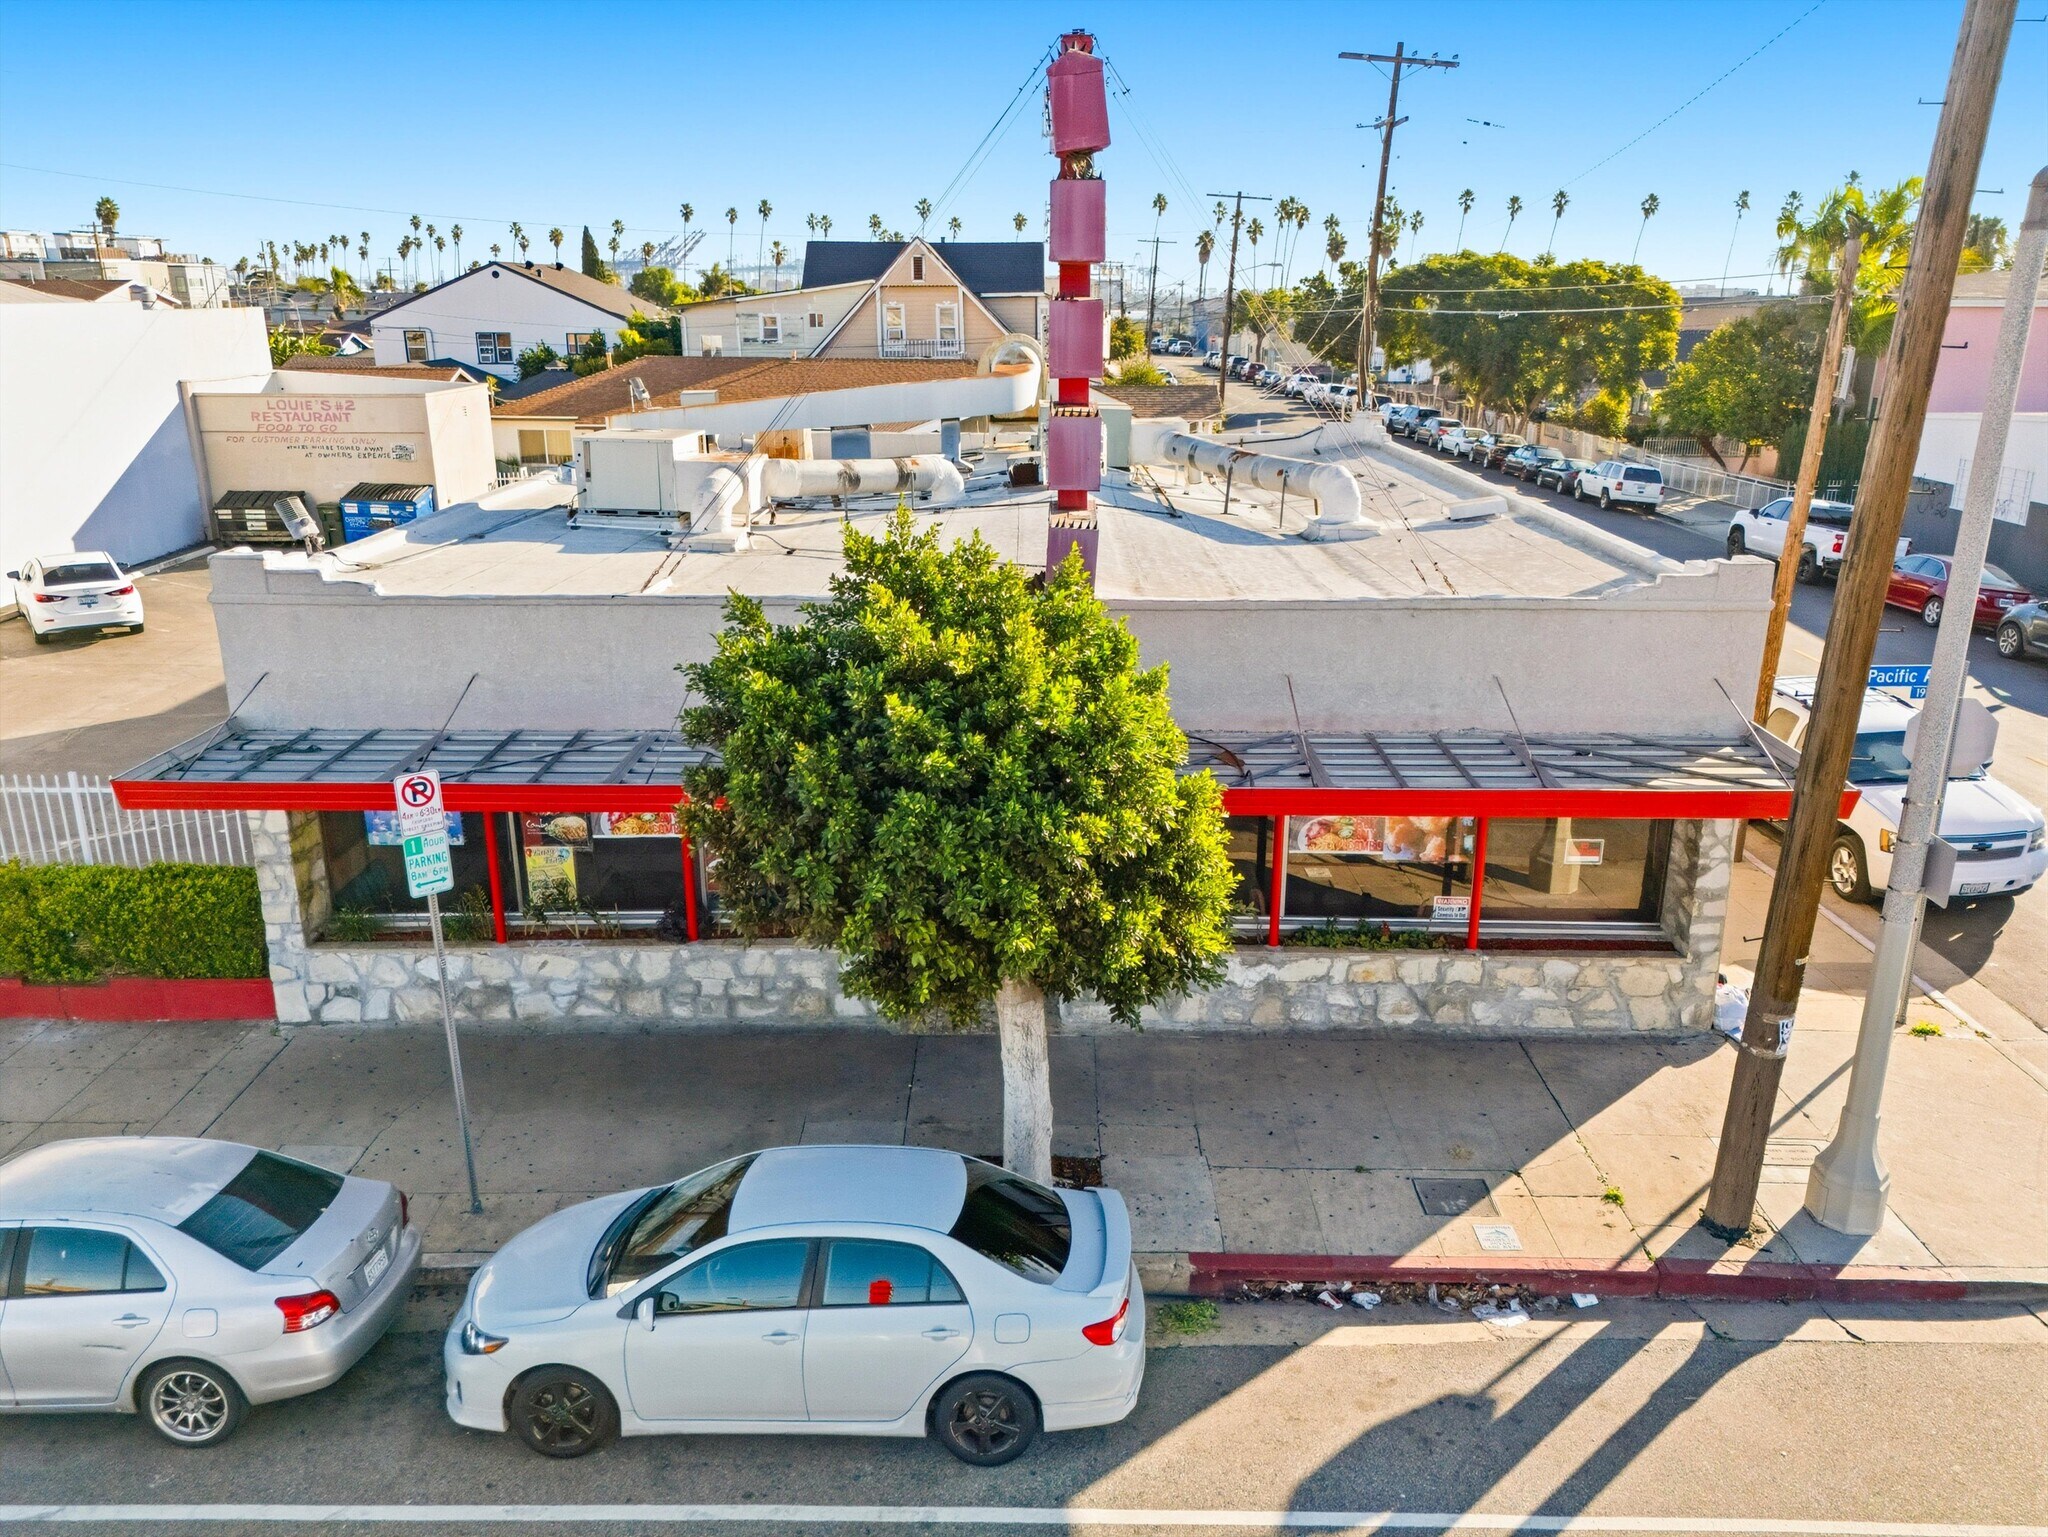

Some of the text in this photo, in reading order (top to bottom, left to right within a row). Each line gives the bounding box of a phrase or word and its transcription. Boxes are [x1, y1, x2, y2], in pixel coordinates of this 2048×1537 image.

[266, 400, 356, 411] LOUIE'S #2
[251, 411, 351, 423] RESTAURANT
[257, 423, 337, 433] FOOD TO GO
[251, 436, 300, 444] CUSTOMER
[303, 436, 345, 444] PARKING
[351, 437, 377, 445] ONLY
[1868, 668, 1918, 683] Pacific
[1916, 688, 1926, 698] 19
[409, 836, 445, 853] 1 HOUR
[408, 851, 448, 869] PARKING
[411, 866, 449, 881] 8AM 6PM
